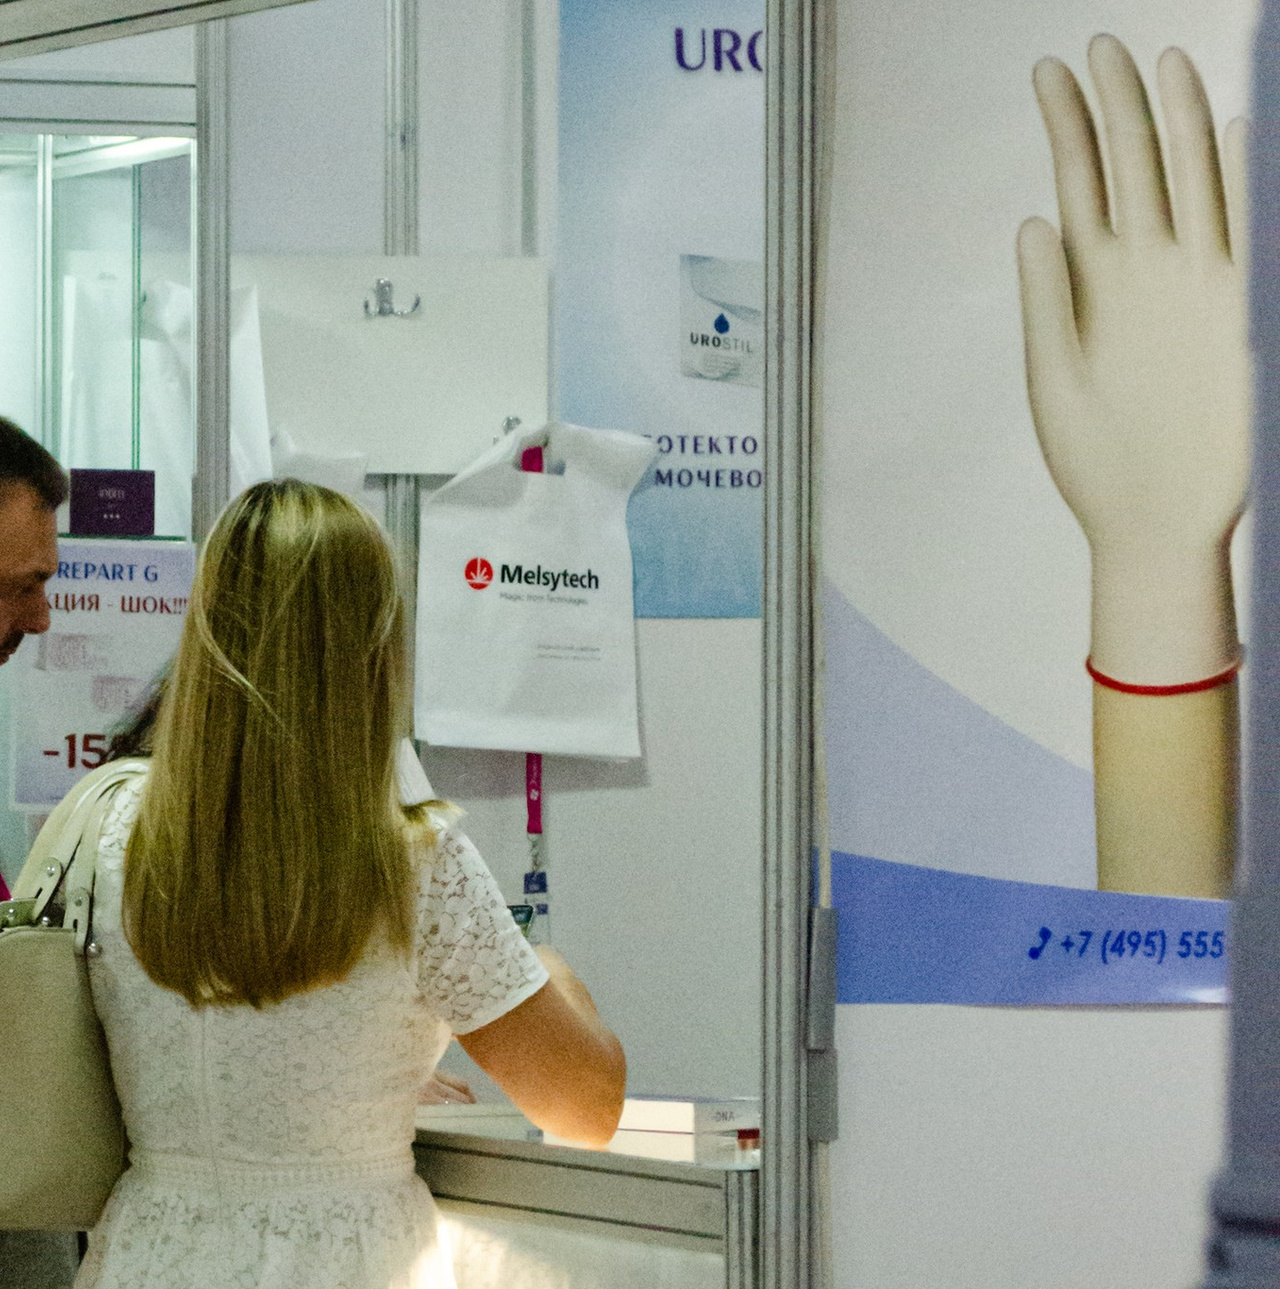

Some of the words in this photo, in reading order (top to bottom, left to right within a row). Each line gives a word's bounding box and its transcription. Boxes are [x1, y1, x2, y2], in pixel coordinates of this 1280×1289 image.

[690, 332, 753, 354] UROSTIL
[640, 434, 758, 455] ОТЕКТО
[655, 468, 762, 489] МОЧЕВО
[144, 564, 159, 582] G
[500, 564, 600, 592] Melsytech
[1061, 930, 1093, 958] +7
[1101, 929, 1167, 964] (495)
[1177, 930, 1224, 959] 555
